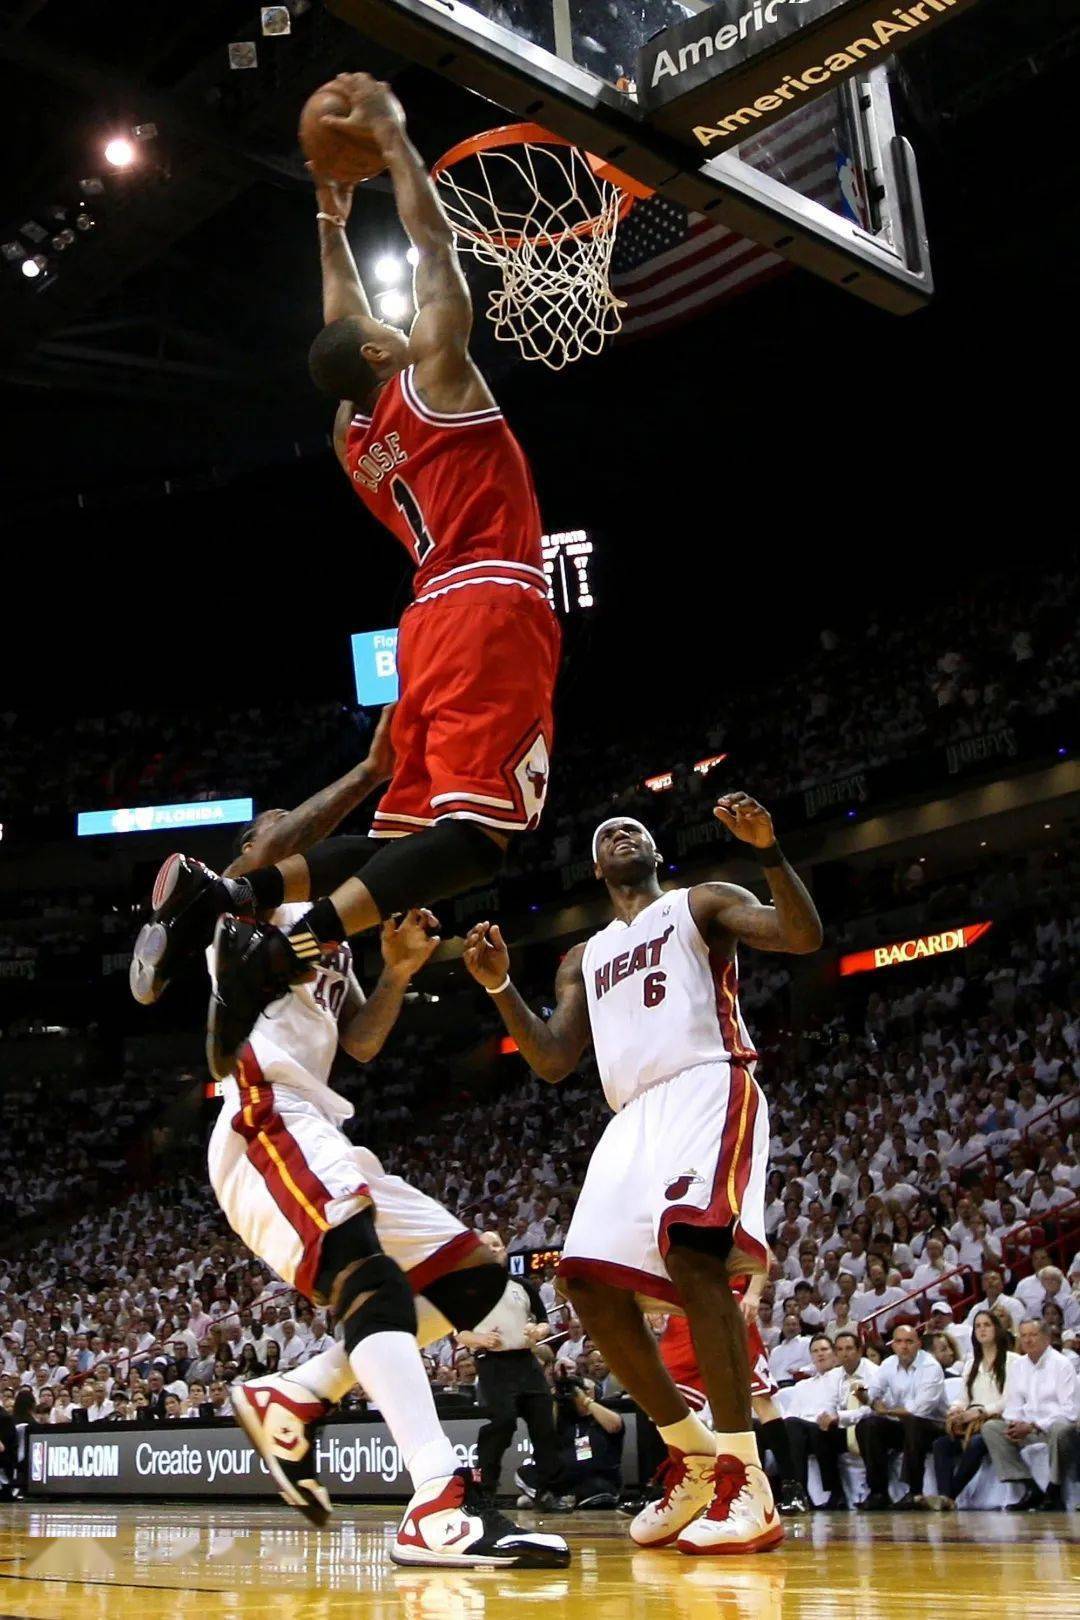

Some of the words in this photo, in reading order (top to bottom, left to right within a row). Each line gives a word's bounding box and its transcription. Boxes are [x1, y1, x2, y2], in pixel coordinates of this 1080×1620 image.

[651, 0, 810, 88] Americ
[390, 473, 436, 567] 1
[595, 924, 675, 1001] HEAT
[874, 929, 965, 968] BACARDI
[643, 971, 667, 1008] 6
[48, 1445, 119, 1477] NBA.COM
[135, 1442, 202, 1476] Create
[207, 1448, 255, 1482] your
